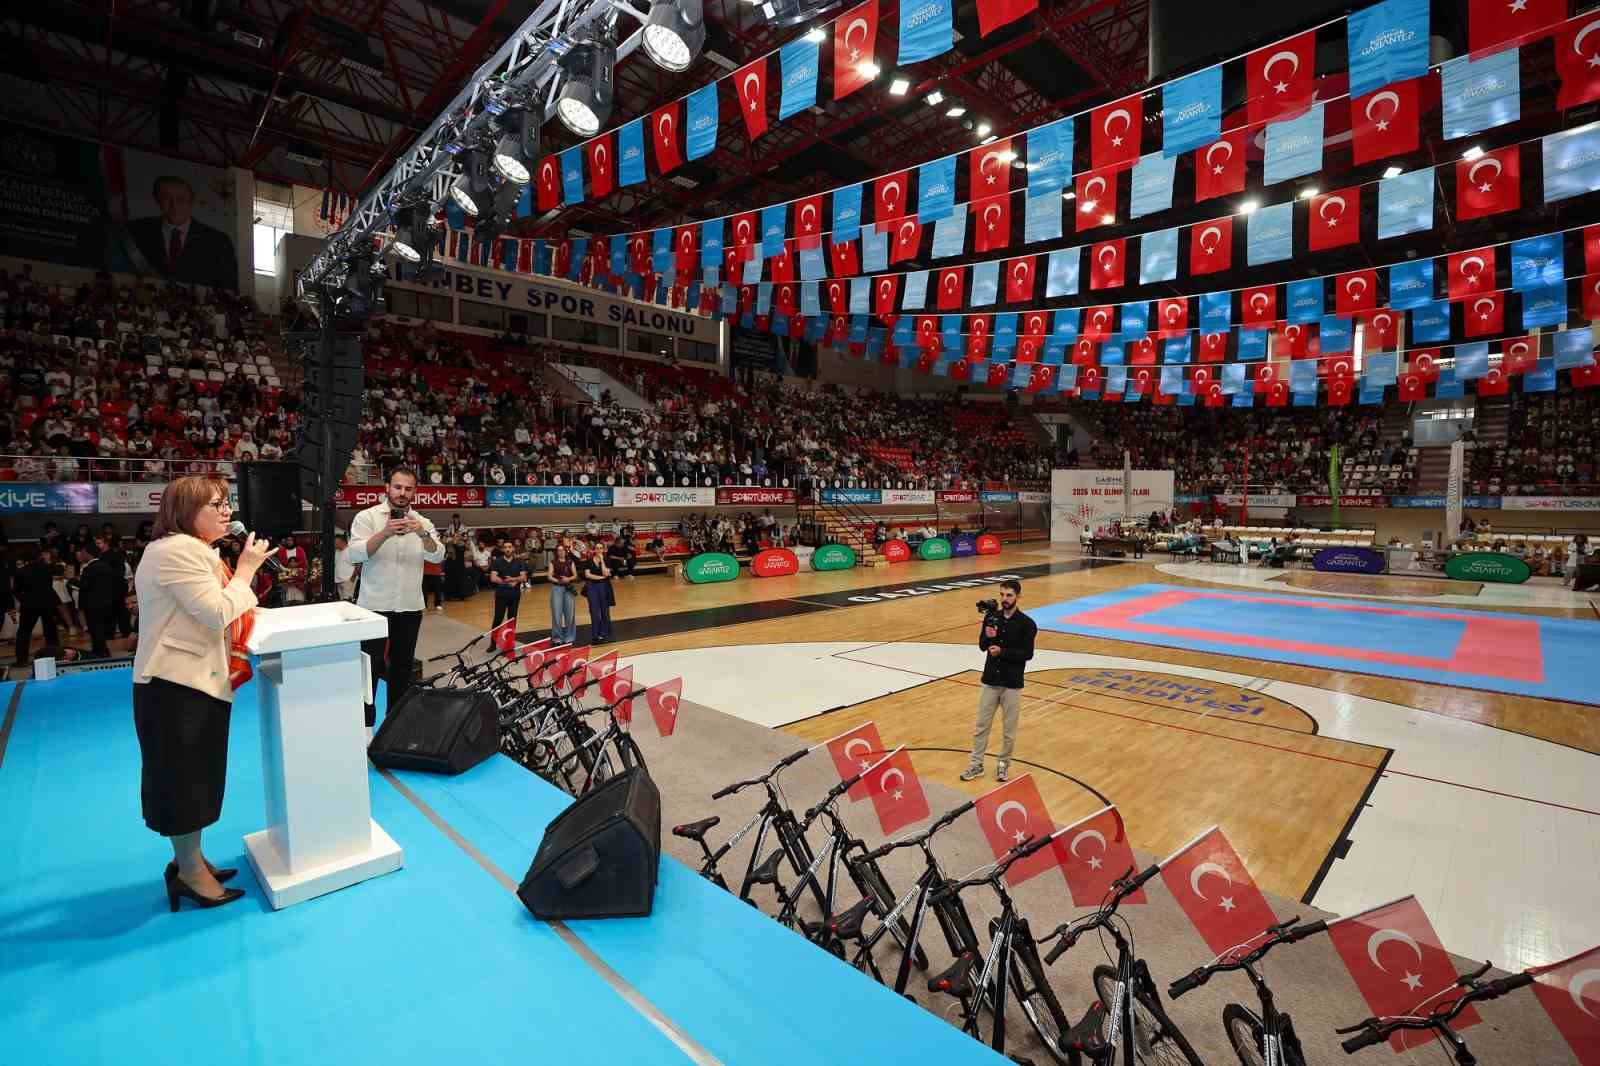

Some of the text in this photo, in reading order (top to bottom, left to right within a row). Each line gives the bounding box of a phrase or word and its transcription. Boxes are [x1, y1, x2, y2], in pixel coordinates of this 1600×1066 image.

[527, 288, 595, 318] SPOR
[608, 304, 696, 336] SALONU
[356, 491, 458, 505] SPOÜRKİYE
